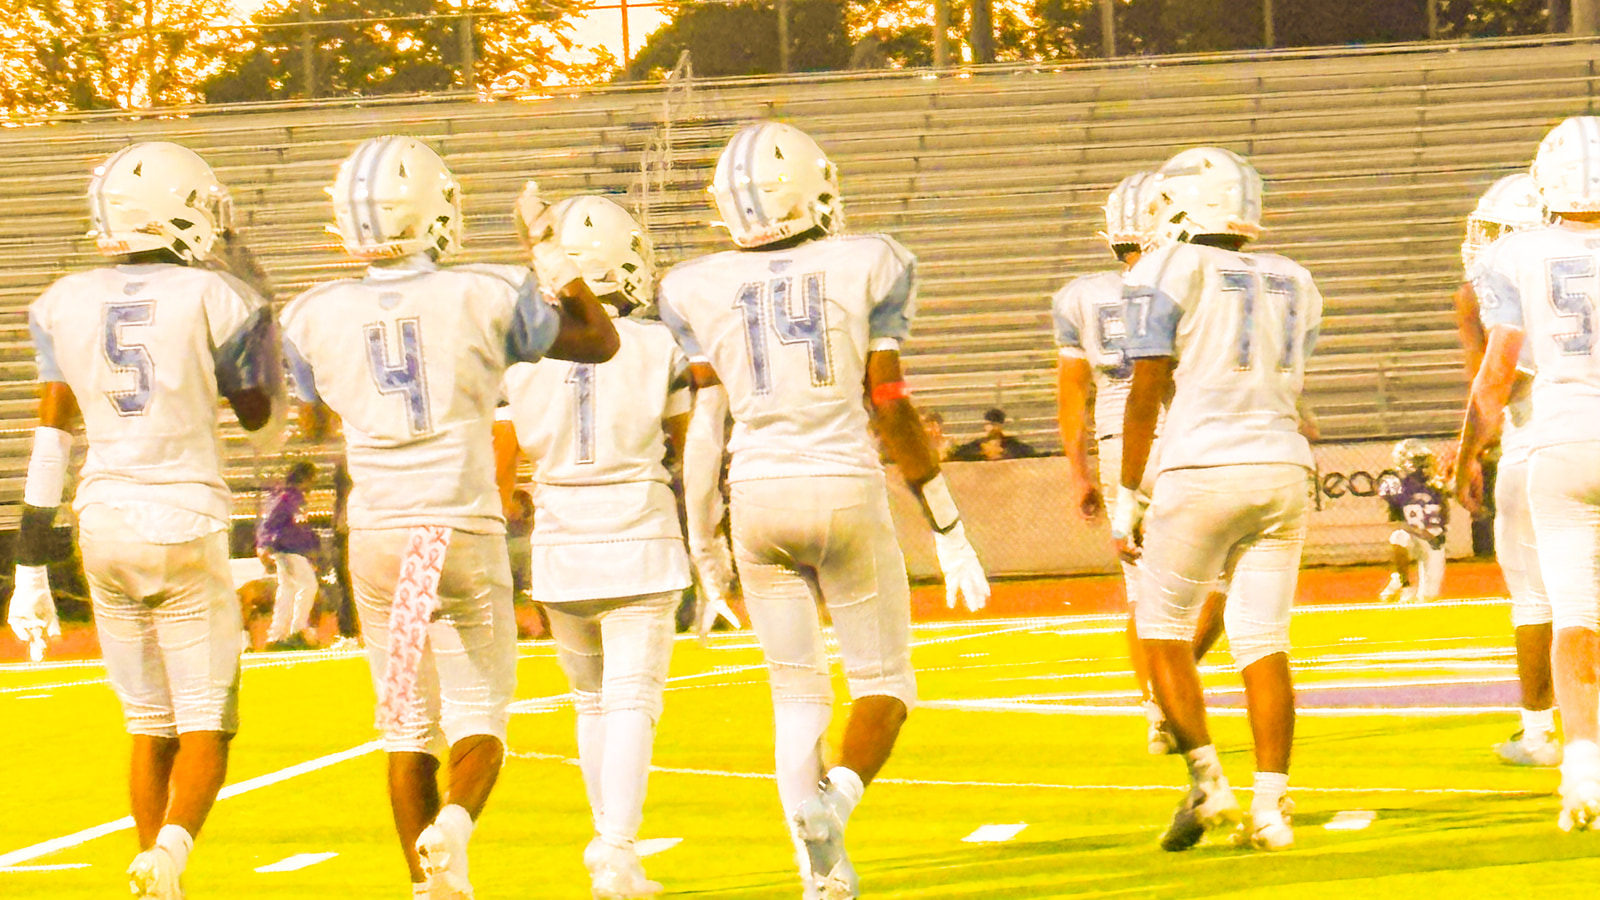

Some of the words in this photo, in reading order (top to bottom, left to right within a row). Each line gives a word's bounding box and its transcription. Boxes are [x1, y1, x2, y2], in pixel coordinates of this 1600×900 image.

[104, 300, 155, 416] 5
[731, 271, 836, 396] 14
[1217, 268, 1298, 373] 77
[1543, 255, 1597, 356] 5
[363, 316, 434, 436] 4
[564, 362, 596, 465] 1
